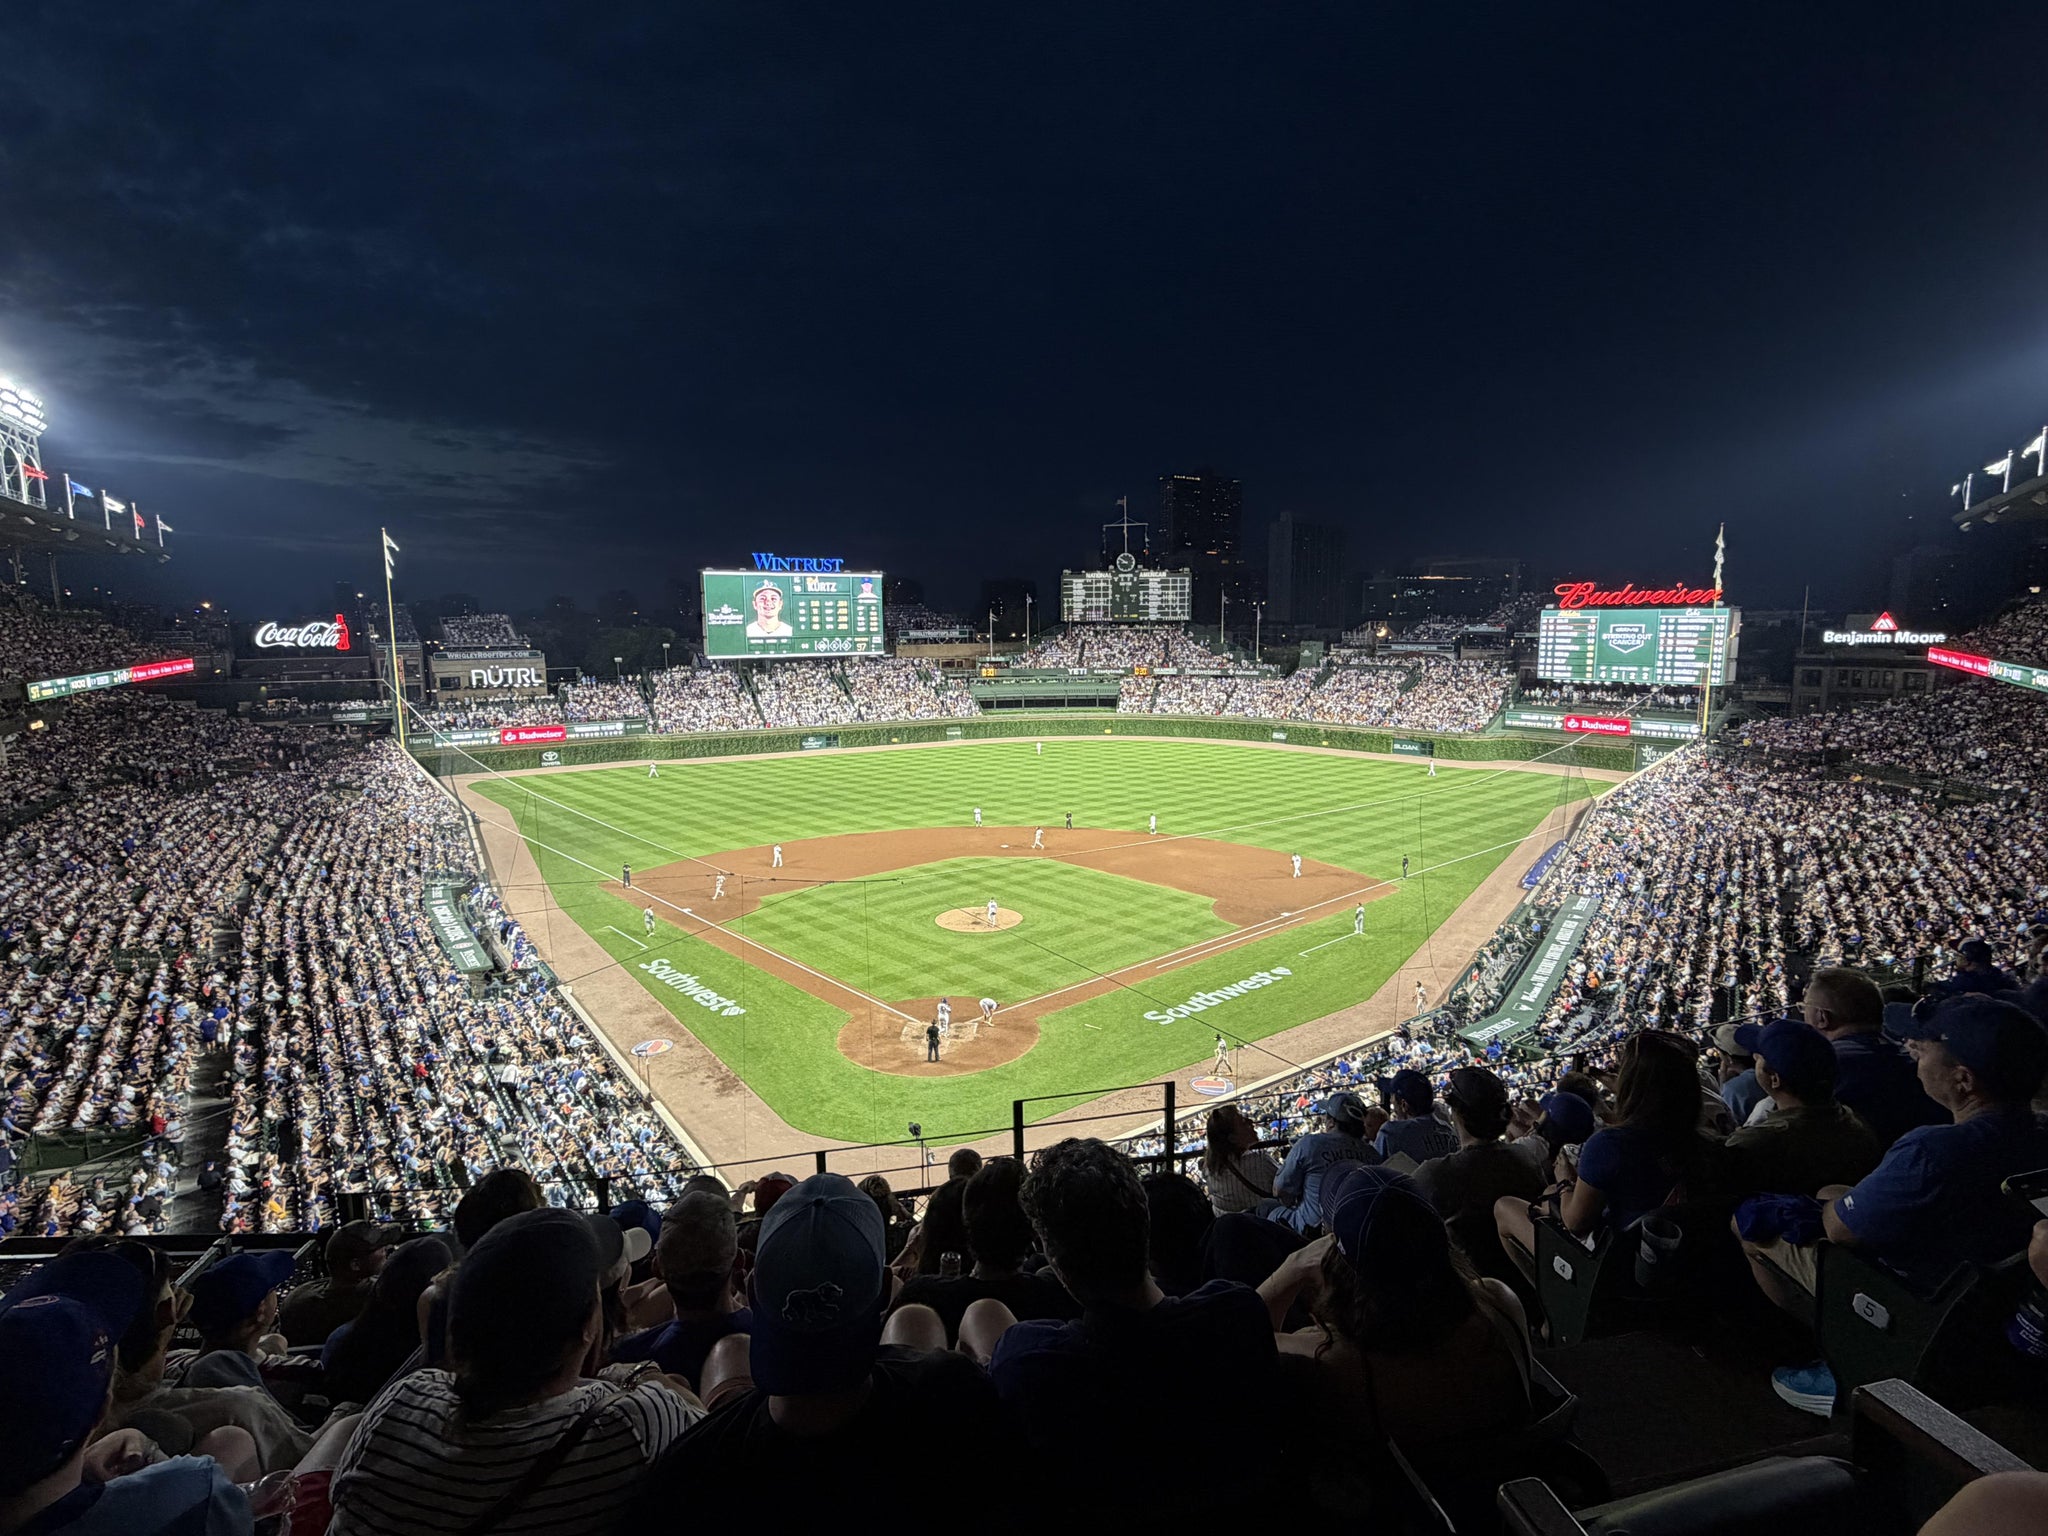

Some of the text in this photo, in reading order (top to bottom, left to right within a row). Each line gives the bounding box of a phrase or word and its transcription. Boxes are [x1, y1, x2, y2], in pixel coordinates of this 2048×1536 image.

[752, 552, 843, 572] WINTRUST
[807, 582, 837, 592] KURTZ
[1554, 582, 1723, 609] Budweiser
[255, 622, 341, 648] Coca-Cola
[1823, 631, 1947, 645] Benjamin Moore
[856, 643, 866, 651] 97
[1185, 667, 1221, 675] Budweiser
[1581, 721, 1626, 732] Budweiser
[409, 736, 433, 745] Harvey
[519, 731, 563, 740] Budweiser
[639, 958, 736, 1011] Southwest
[1143, 971, 1283, 1025] Southwest
[1560, 1263, 1566, 1273] 4
[1863, 1303, 1875, 1318] 5
